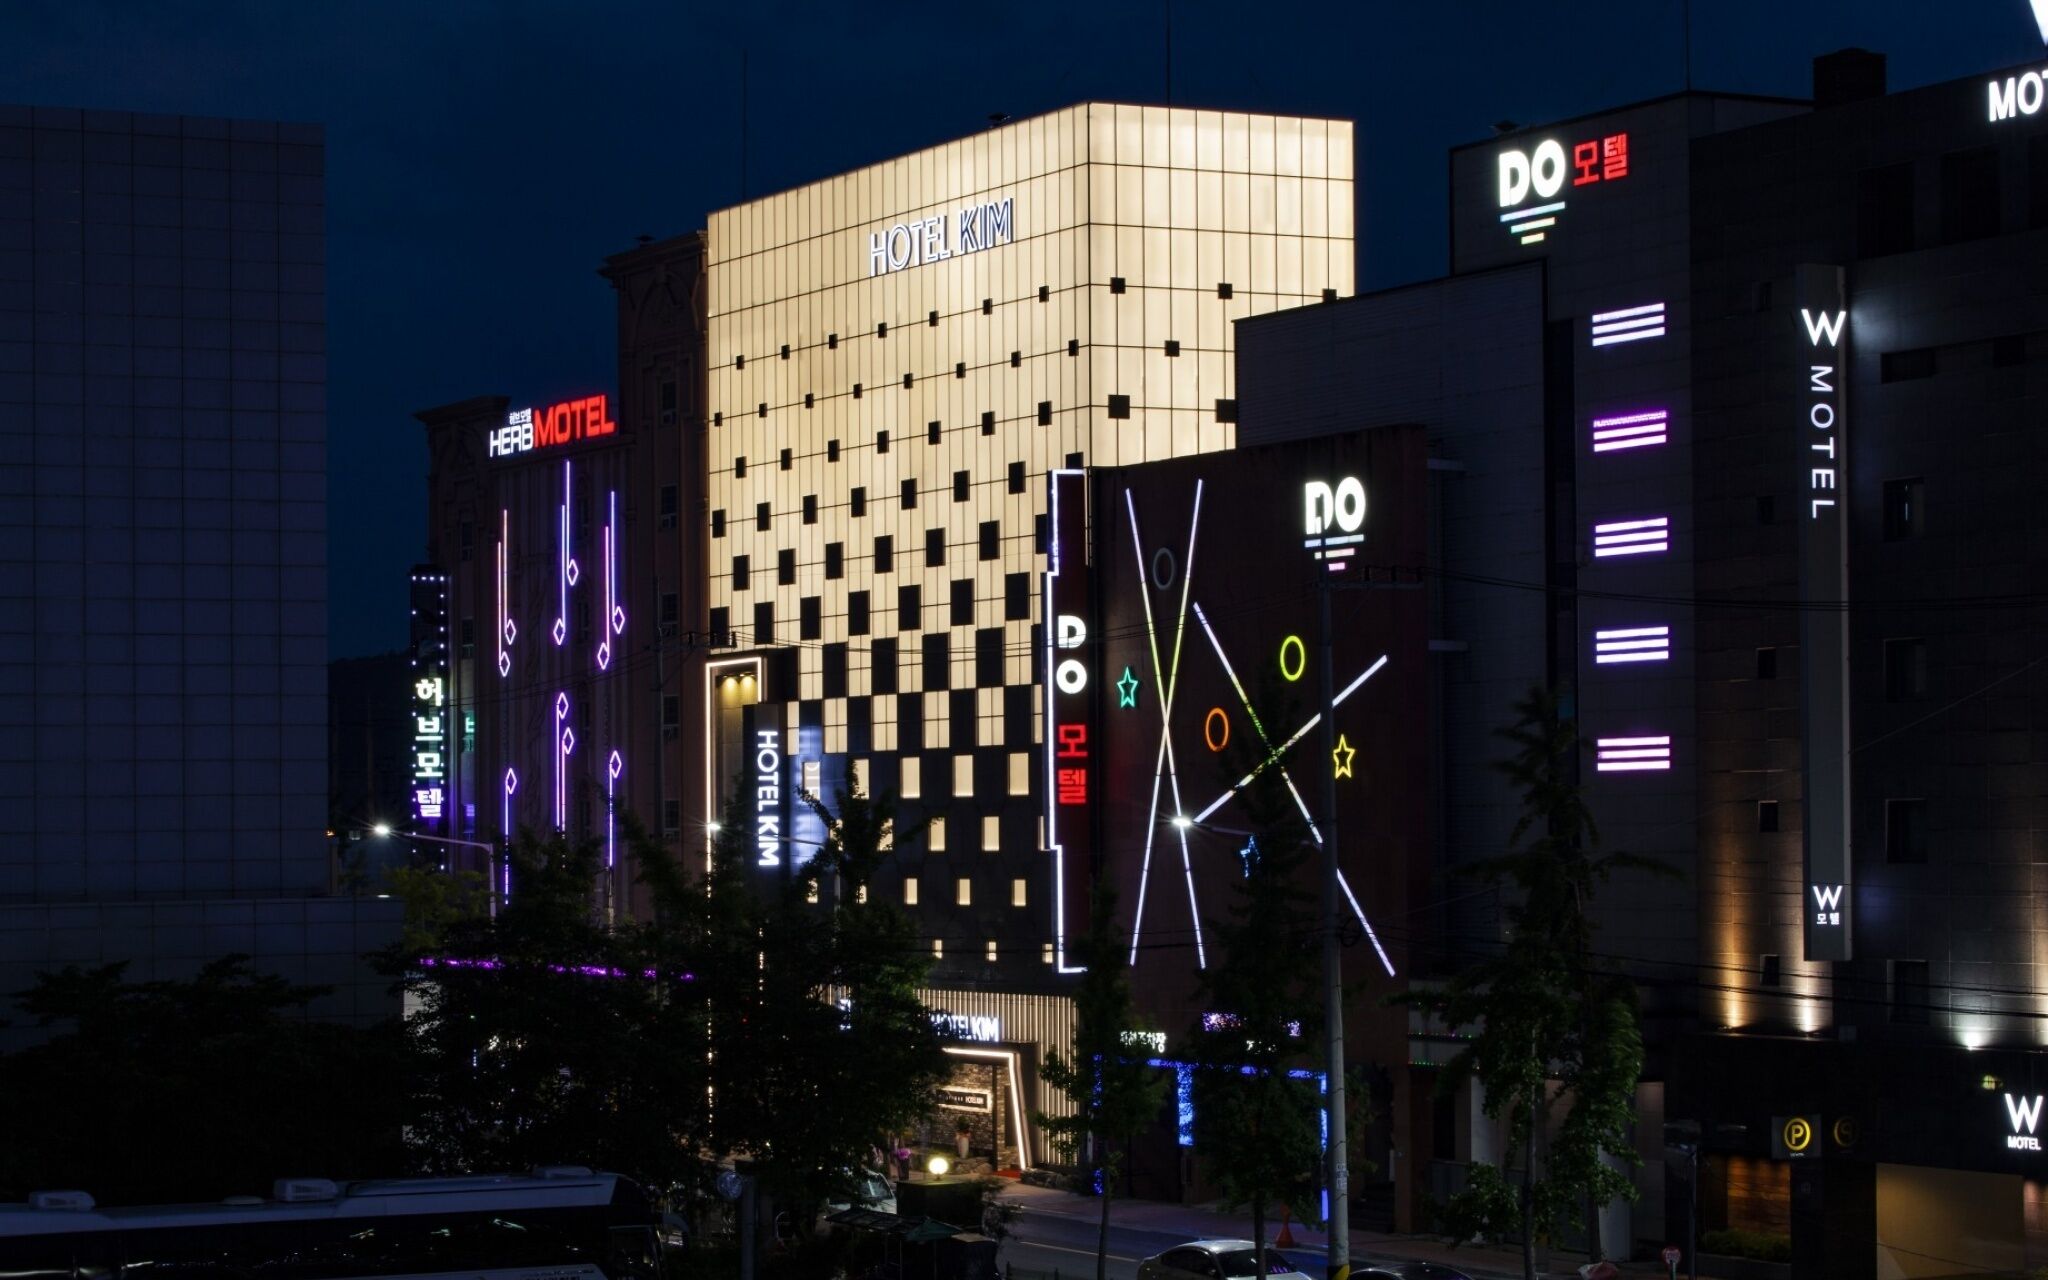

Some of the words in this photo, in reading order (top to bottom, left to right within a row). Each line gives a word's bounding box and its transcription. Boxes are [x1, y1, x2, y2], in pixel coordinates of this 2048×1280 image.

[1497, 138, 1567, 208] DO
[1573, 133, 1628, 186] 모텔
[869, 214, 953, 277] HOTEL
[959, 197, 1014, 254] KIM
[1801, 308, 1847, 347] W
[1810, 365, 1835, 519] MOTEL
[1304, 476, 1367, 535] DO
[1056, 615, 1088, 694] DO
[415, 677, 444, 818] 허브모텔
[757, 730, 780, 812] HOTEL
[1057, 724, 1088, 805] 모텔
[757, 816, 780, 867] KIM
[1812, 885, 1844, 911] W
[1816, 912, 1840, 926] 모텔
[2004, 1093, 2044, 1134] W
[2007, 1135, 2042, 1151] MOTEL
